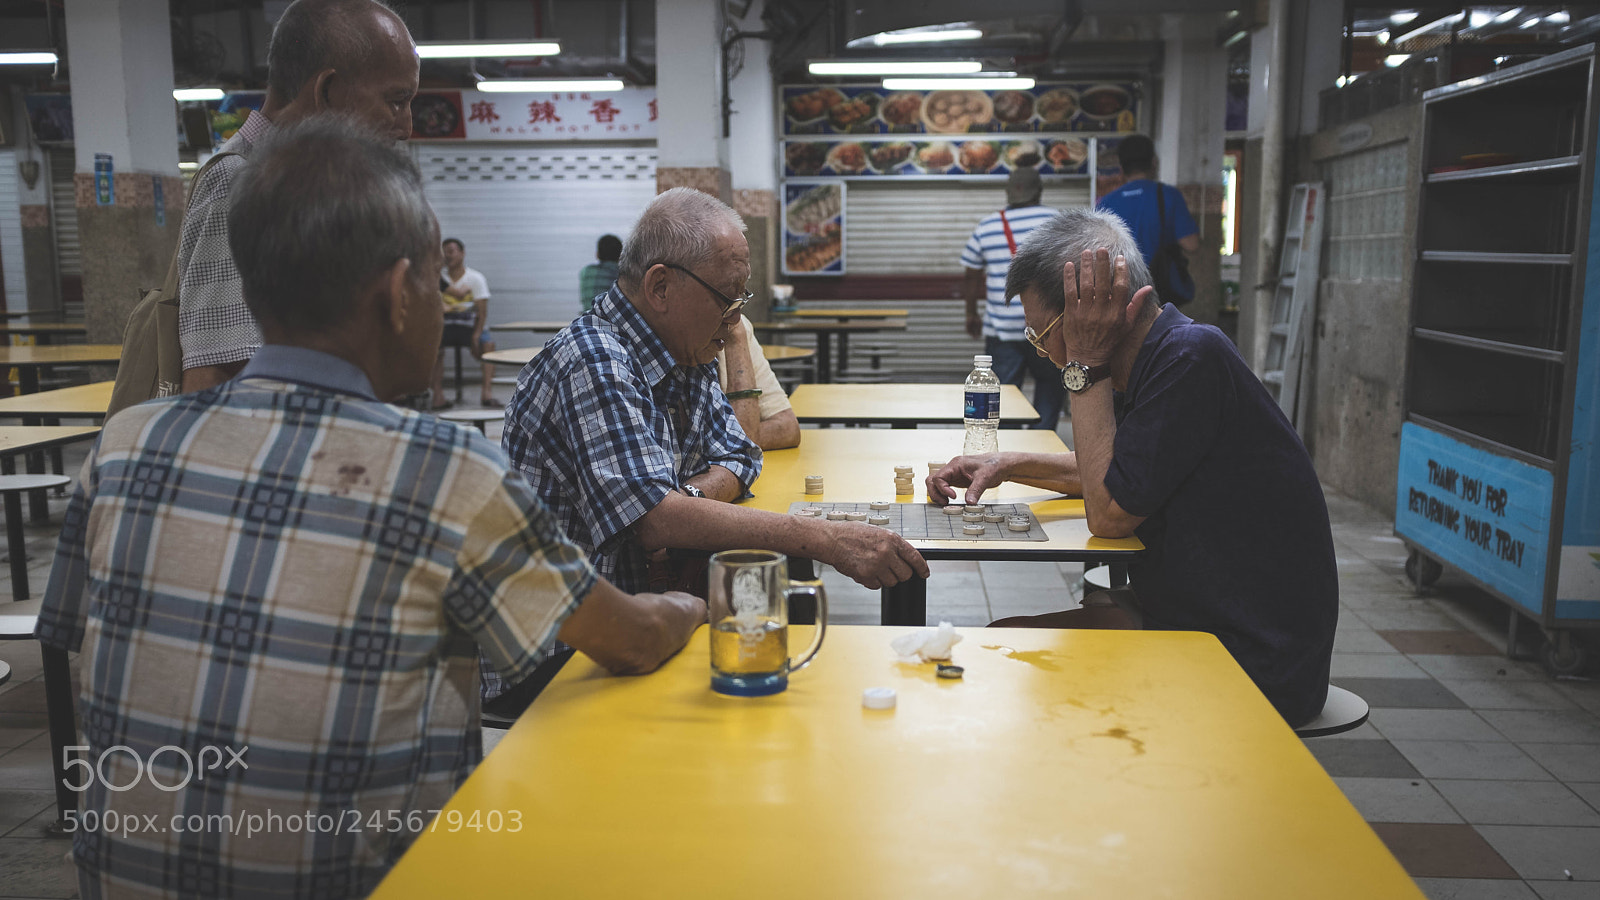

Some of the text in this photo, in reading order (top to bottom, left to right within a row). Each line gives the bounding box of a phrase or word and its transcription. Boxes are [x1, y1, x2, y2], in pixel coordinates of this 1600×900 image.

[490, 123, 641, 133] MALA HOT POT
[1428, 458, 1508, 517] THANK YOU FOR
[1408, 485, 1460, 534] RETURNING
[1495, 527, 1525, 568] TRAY
